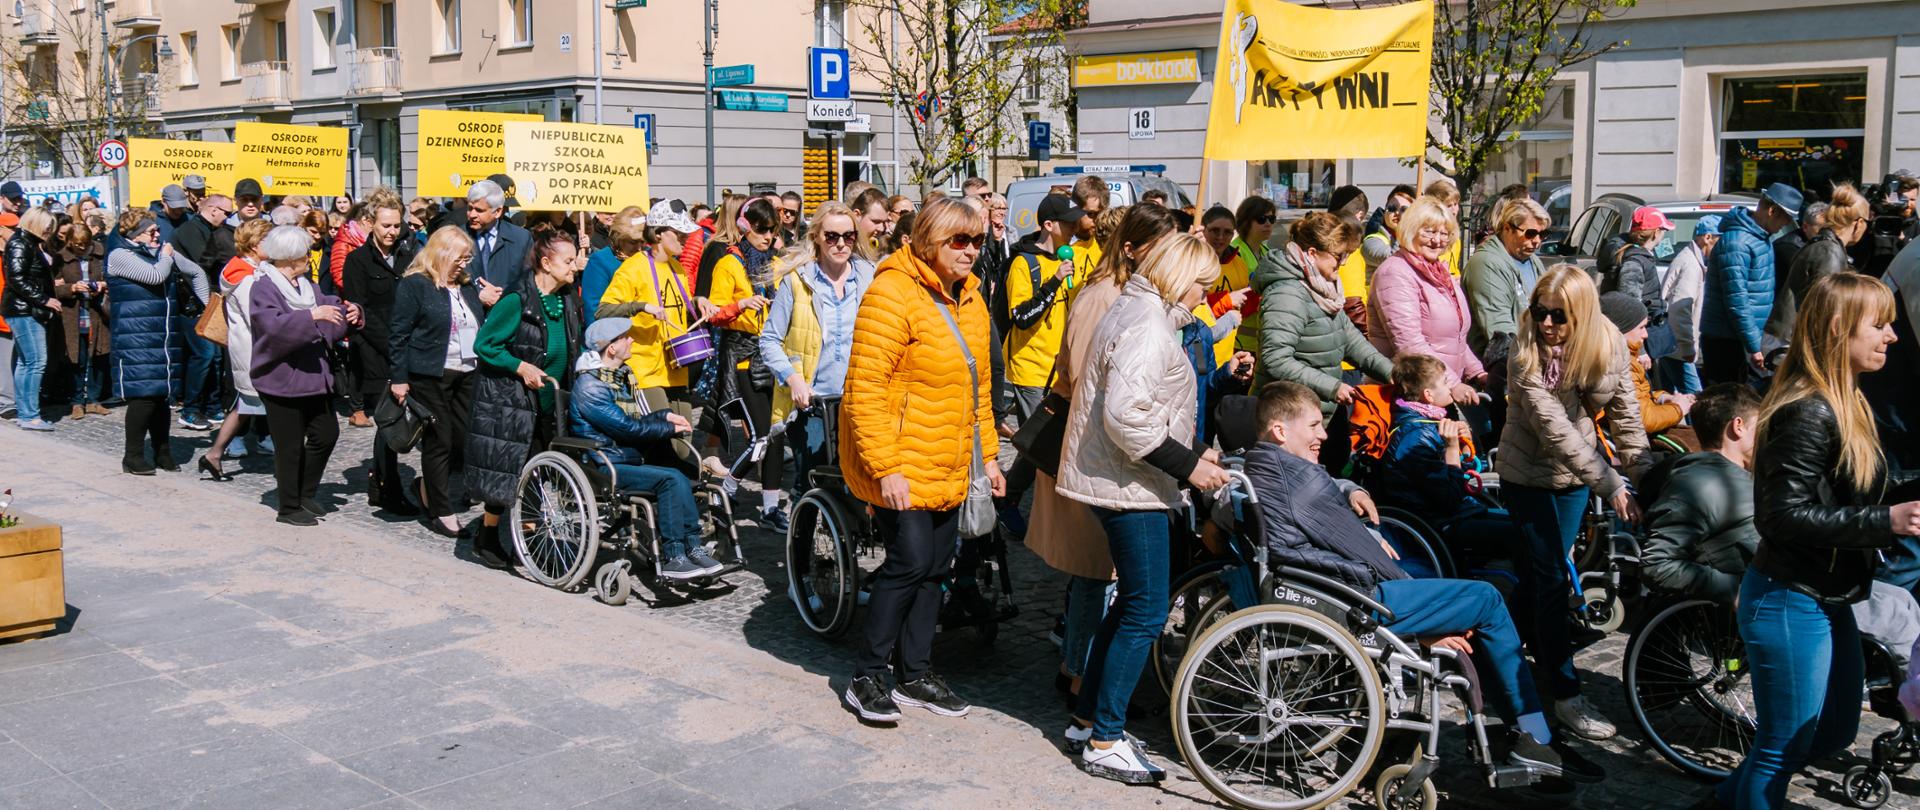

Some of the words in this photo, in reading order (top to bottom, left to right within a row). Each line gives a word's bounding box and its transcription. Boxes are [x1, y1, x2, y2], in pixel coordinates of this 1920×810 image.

[561, 35, 570, 45] 20
[821, 53, 842, 92] P
[1116, 56, 1194, 80] bookbook
[1133, 110, 1150, 129] 18
[457, 121, 503, 133] OŚRODE
[271, 132, 318, 144] OŚRODEK
[426, 136, 494, 149] DZIENNEGO
[530, 129, 624, 145] NIEPUBLICZNA
[104, 147, 125, 161] 30
[163, 148, 214, 158] OŚRODEK
[242, 145, 303, 156] DZIENNEGO
[305, 147, 343, 157] POBYTU
[554, 146, 605, 159] SZKOŁA
[266, 157, 321, 168] Hetmańska
[461, 153, 505, 164] Staszica
[134, 160, 198, 170] DZIENNEGO
[201, 162, 235, 172] POBYT
[513, 161, 643, 178] PRZYSPOSABIAJĄCA
[23, 183, 87, 193] ARZYSZENIE
[549, 178, 569, 189] DO
[573, 179, 614, 190] PRACY
[552, 194, 613, 206] AKTYWNI
[1302, 596, 1317, 606] PRO
